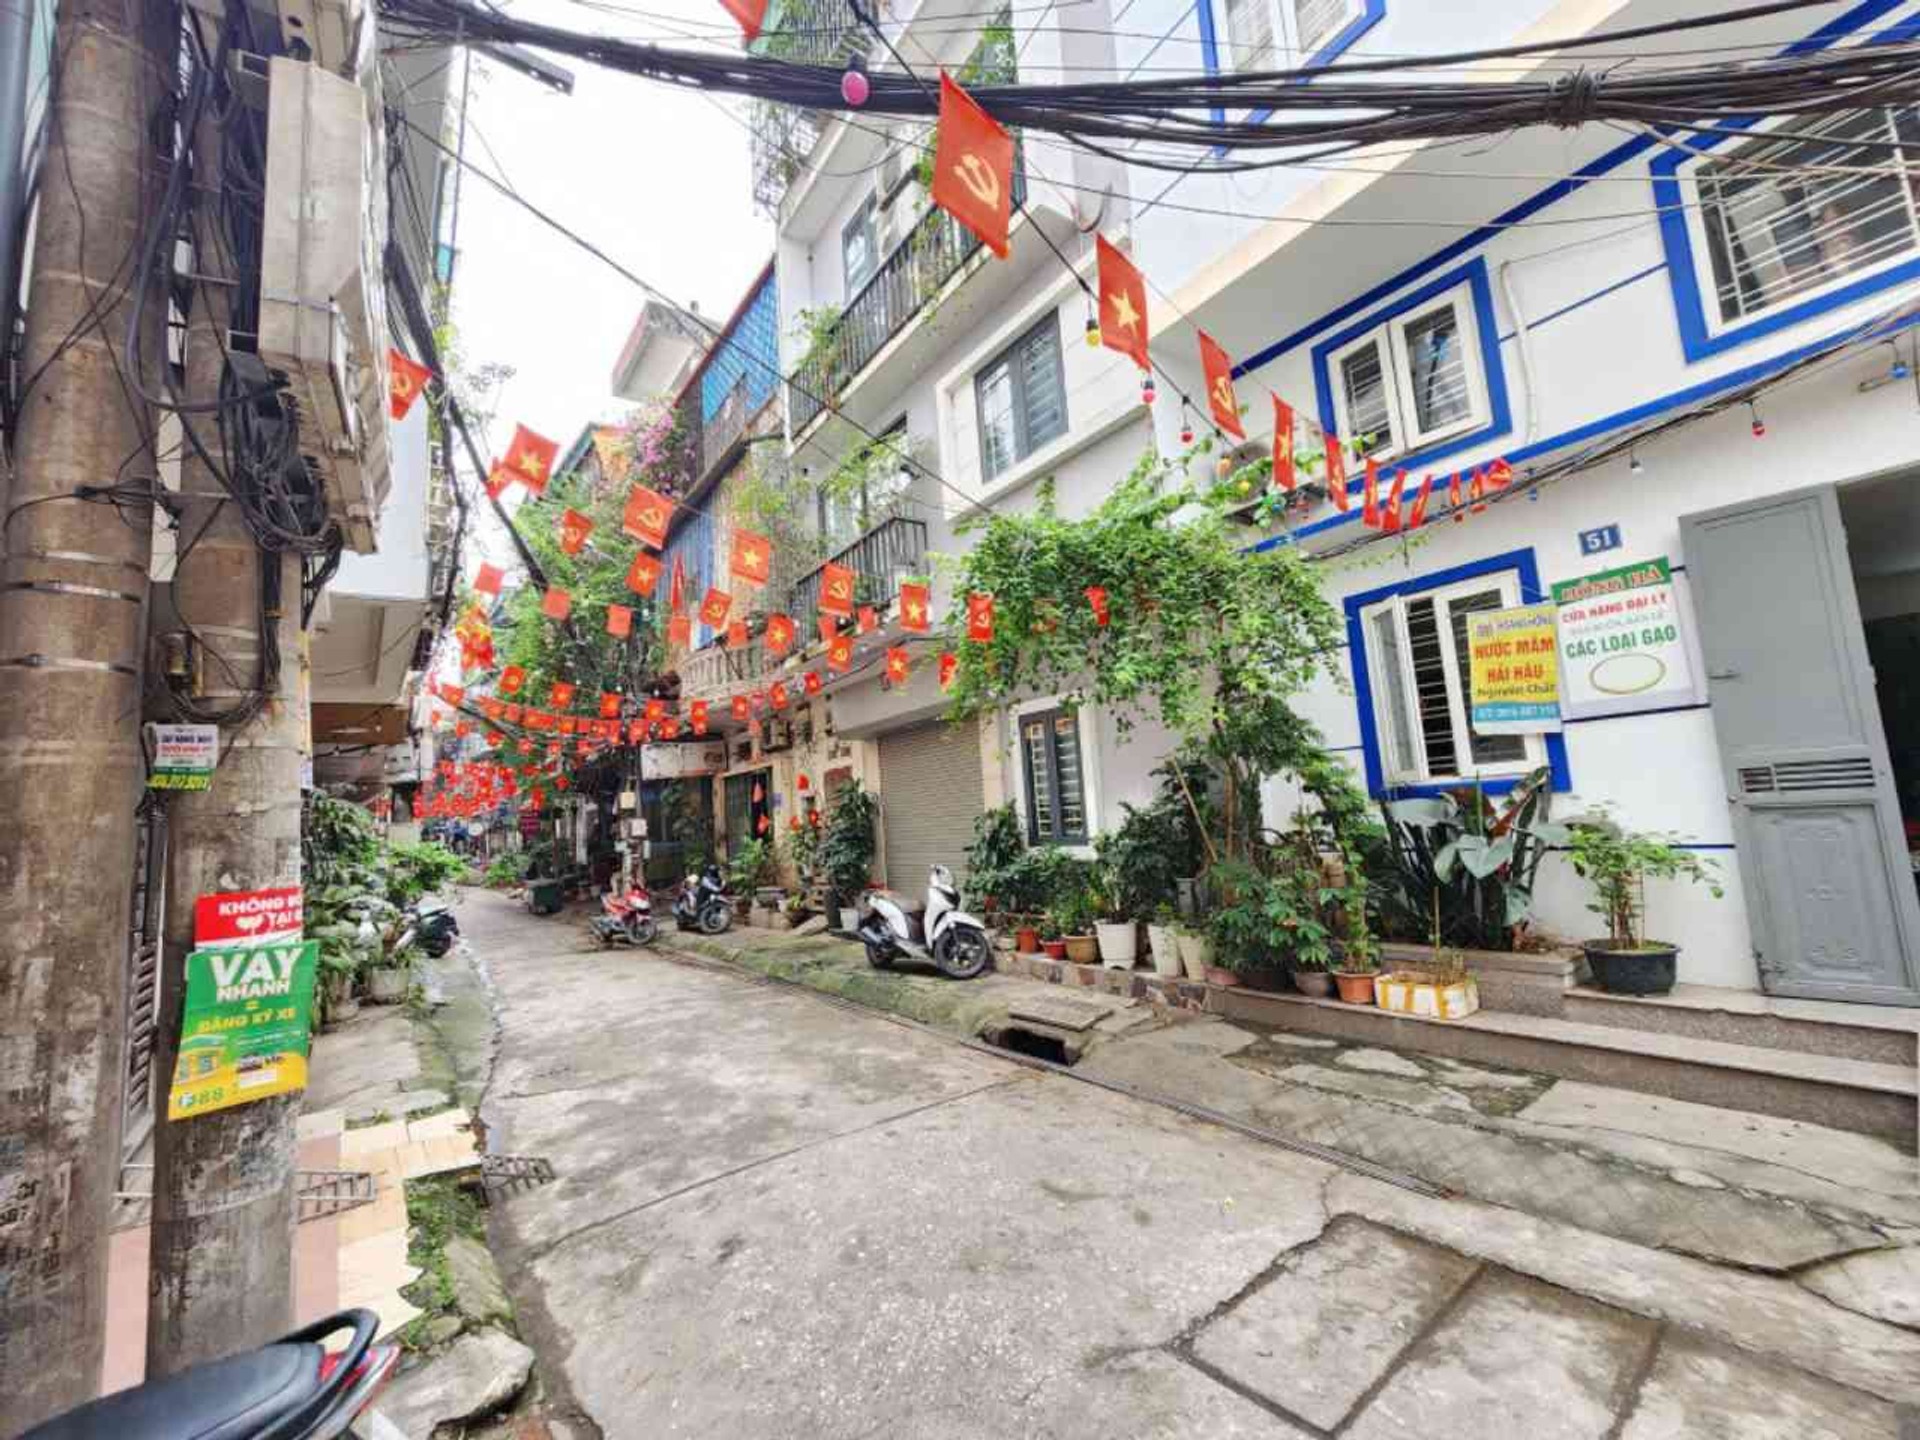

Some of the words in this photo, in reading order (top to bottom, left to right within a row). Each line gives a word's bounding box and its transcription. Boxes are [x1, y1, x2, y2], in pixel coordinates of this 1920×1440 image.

[1587, 530, 1612, 550] 51
[218, 896, 285, 916] KHÔNG
[211, 948, 304, 987] VAY
[216, 981, 289, 1002] NHANH
